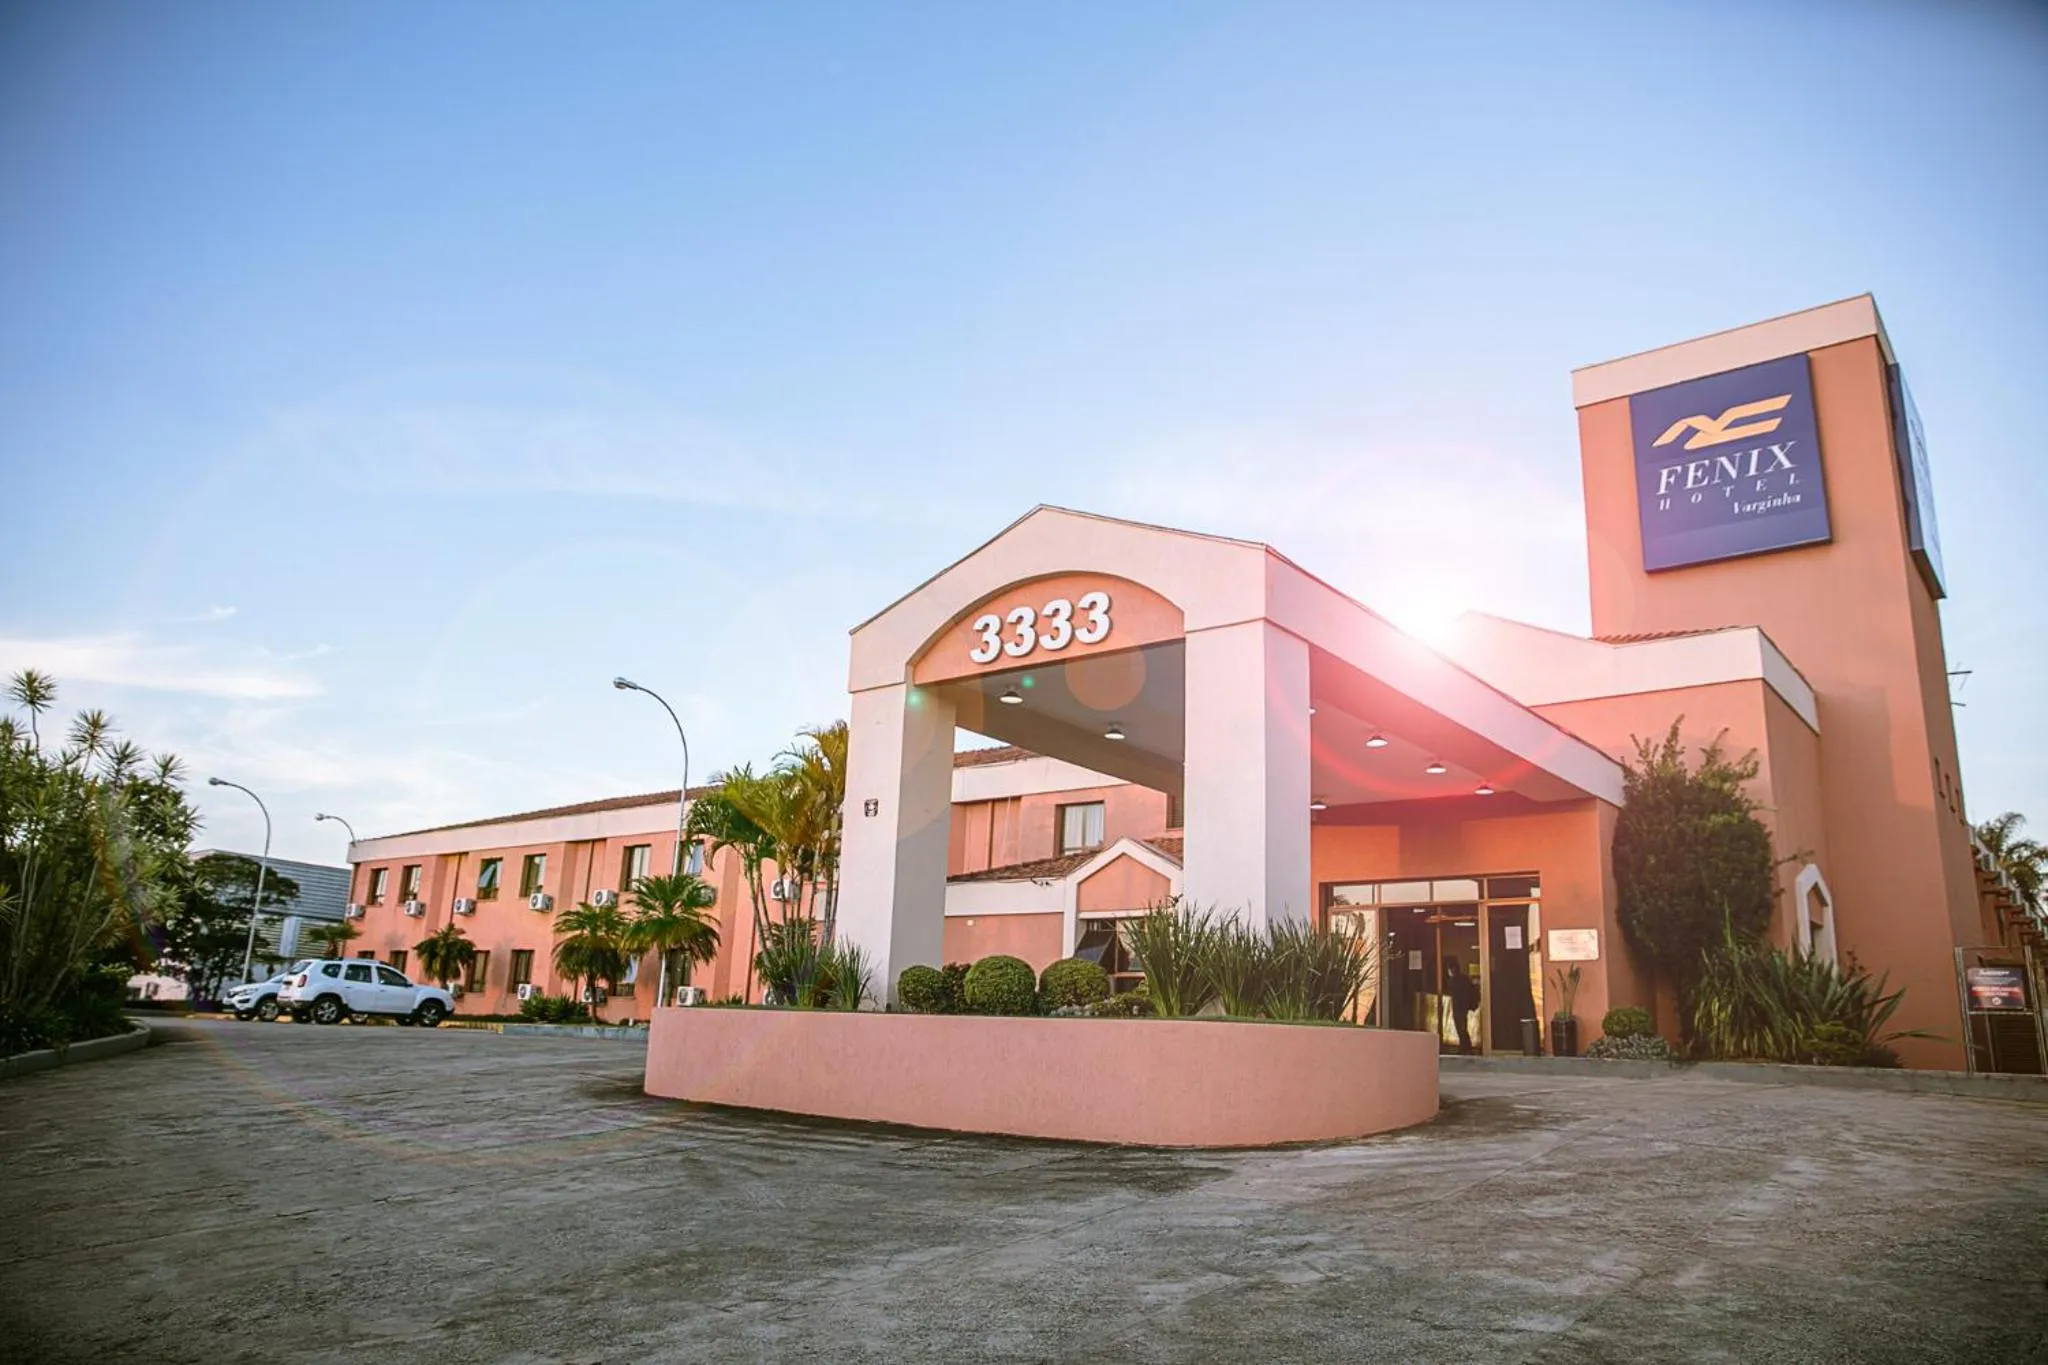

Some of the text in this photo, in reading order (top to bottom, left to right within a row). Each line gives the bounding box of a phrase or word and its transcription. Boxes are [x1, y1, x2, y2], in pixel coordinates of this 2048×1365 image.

[1656, 440, 1797, 495] FENIX
[1733, 492, 1801, 514] Varginha
[969, 591, 1111, 664] 3333
